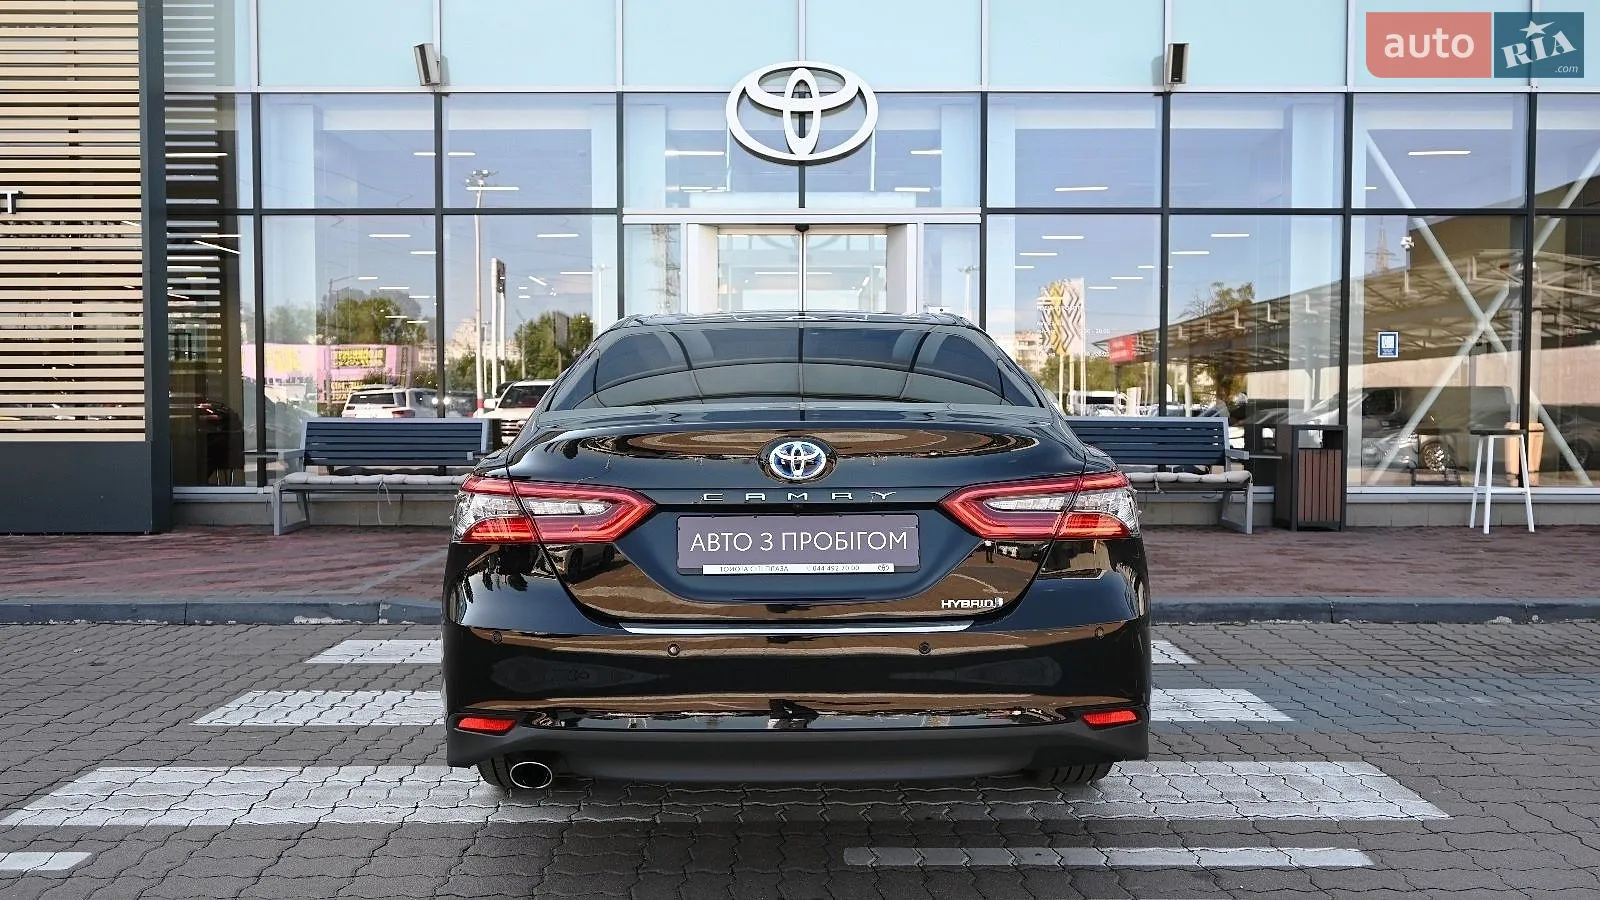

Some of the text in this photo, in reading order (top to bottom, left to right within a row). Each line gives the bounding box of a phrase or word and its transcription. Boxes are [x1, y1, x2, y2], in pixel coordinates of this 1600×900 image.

[703, 491, 896, 501] CAMRY
[690, 532, 753, 552] АВТО
[782, 531, 908, 551] ПРОБІГОМ
[941, 599, 994, 609] HYBRID
